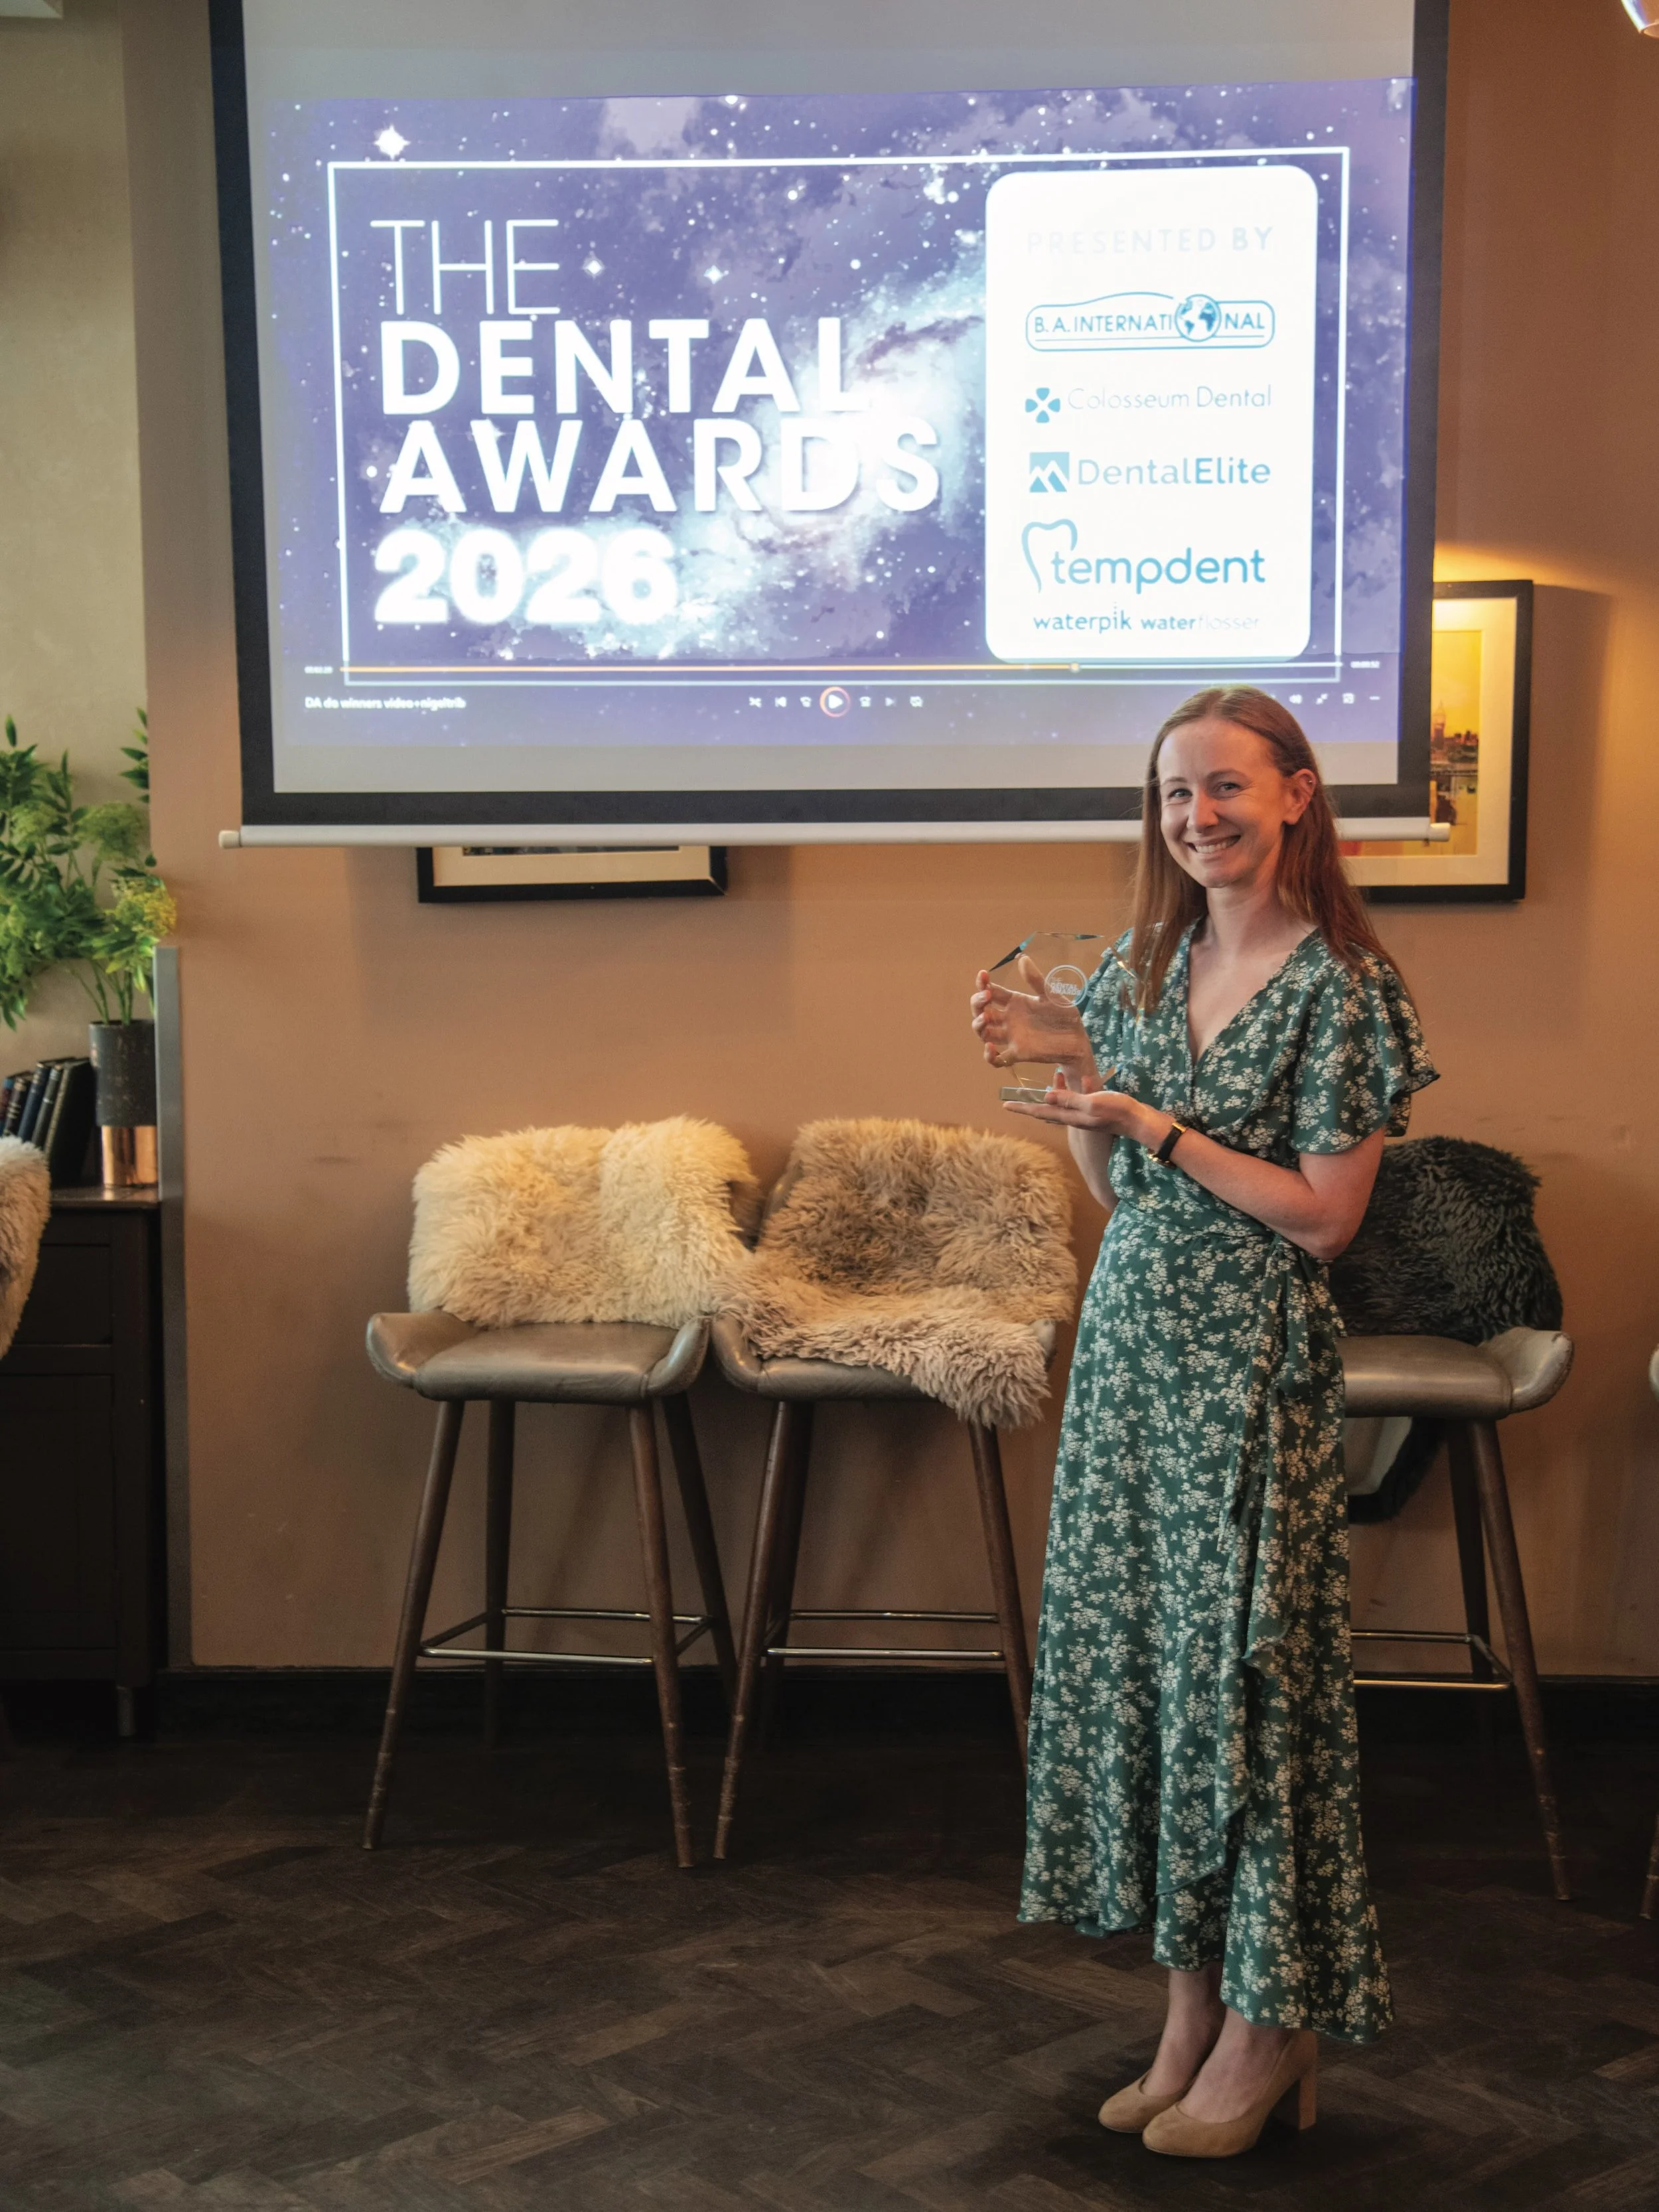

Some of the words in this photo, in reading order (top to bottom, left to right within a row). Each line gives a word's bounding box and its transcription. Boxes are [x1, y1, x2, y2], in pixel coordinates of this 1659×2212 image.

[1027, 228, 1216, 255] PRESENTED
[1232, 226, 1273, 252] BY
[370, 219, 561, 315] THE
[380, 317, 868, 415] DENTAL
[1067, 386, 1190, 410] Colosseum
[1196, 384, 1271, 408] Dental
[379, 417, 940, 513] AWARDS
[1078, 456, 1271, 485] DentalElite
[374, 528, 678, 625] 2026
[1050, 547, 1266, 595] tempdent
[1033, 602, 1133, 634] waterpik
